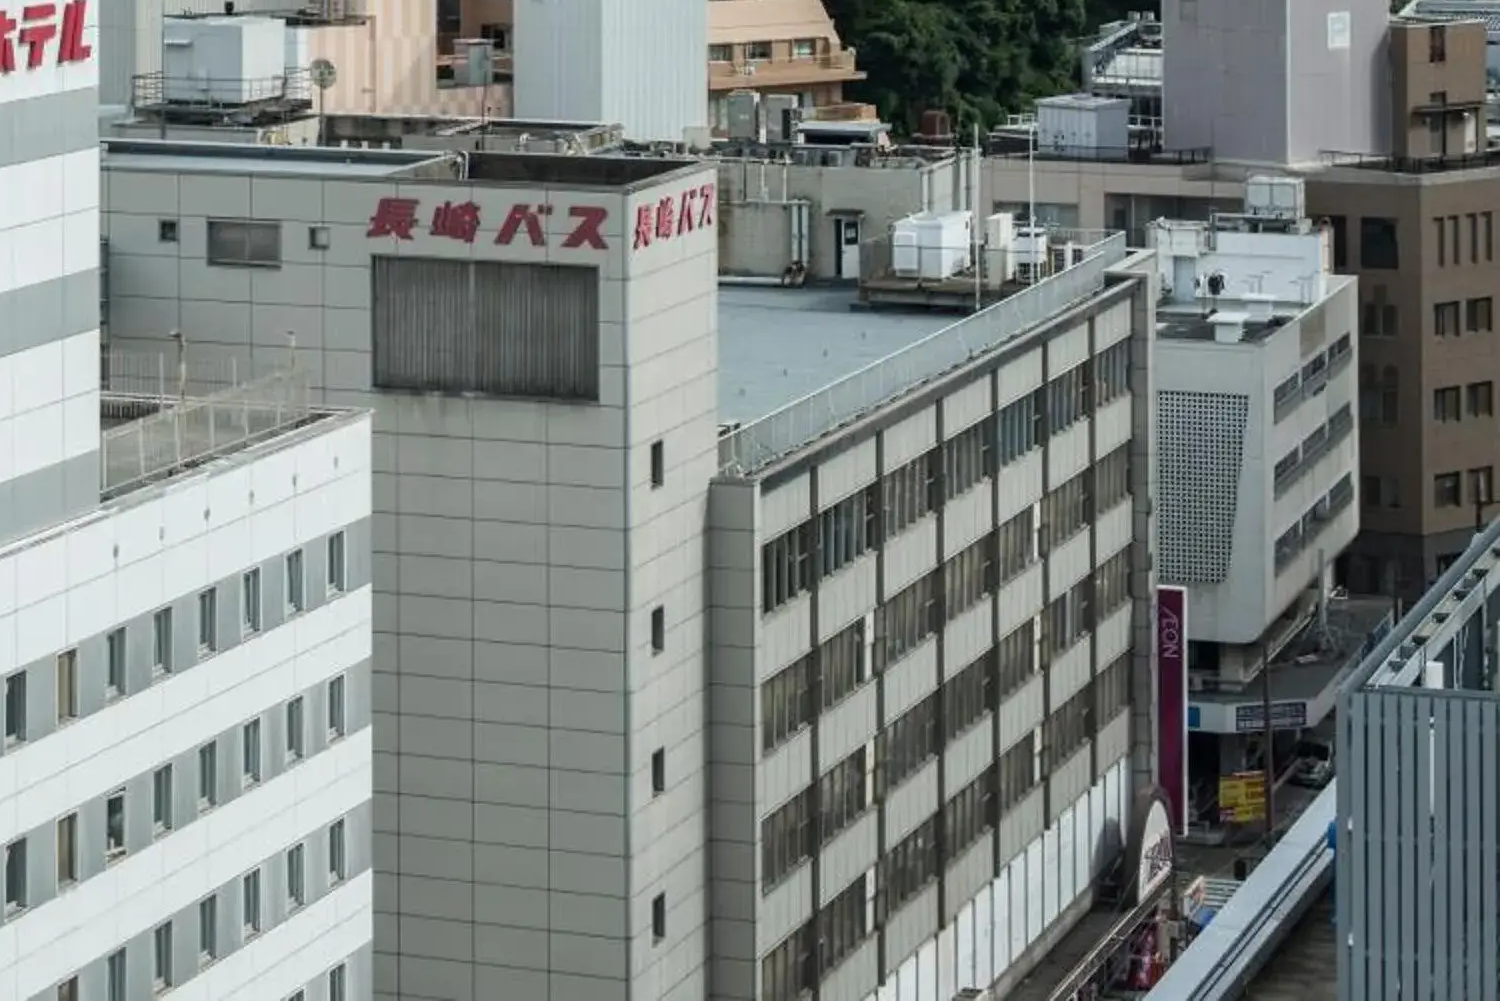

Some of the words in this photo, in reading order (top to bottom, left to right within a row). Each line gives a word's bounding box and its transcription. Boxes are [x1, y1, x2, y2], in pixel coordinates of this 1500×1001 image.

[365, 197, 609, 251] 長崎バス
[632, 182, 716, 251] 長崎バス
